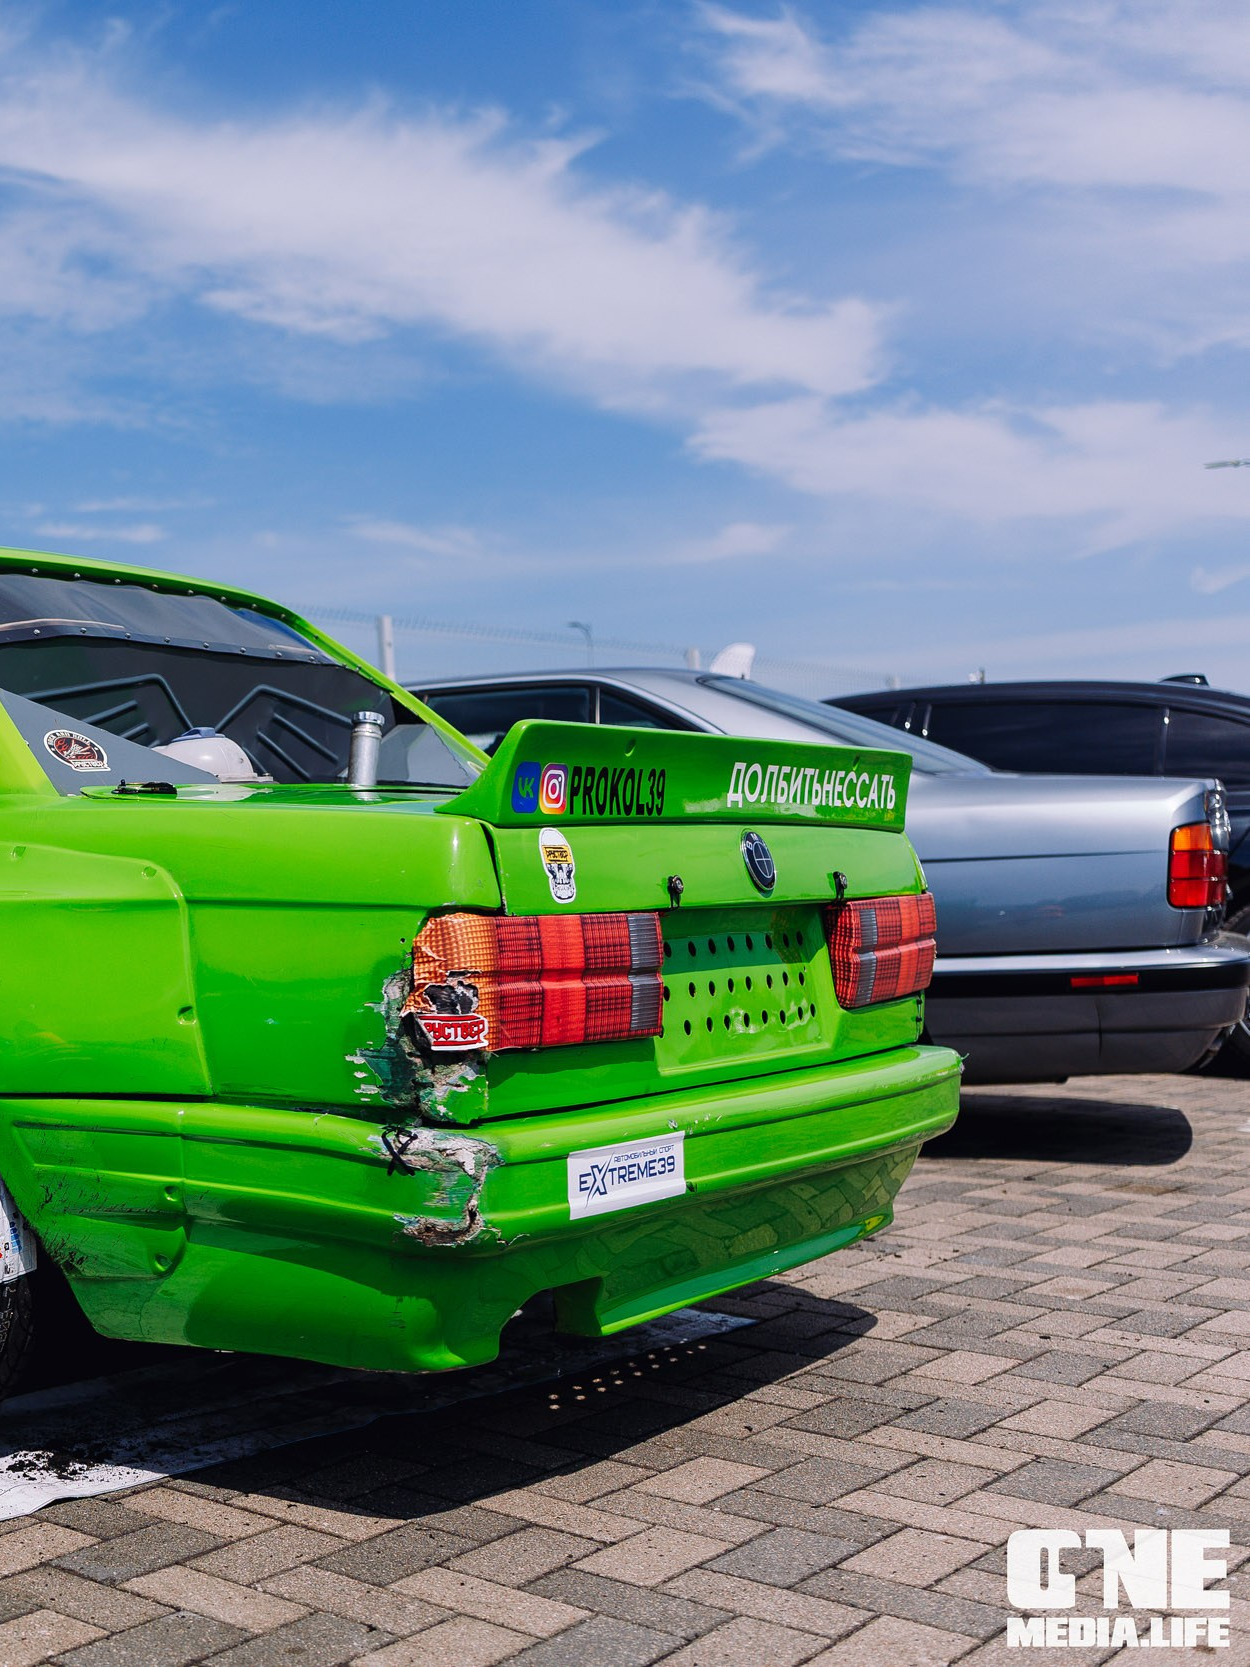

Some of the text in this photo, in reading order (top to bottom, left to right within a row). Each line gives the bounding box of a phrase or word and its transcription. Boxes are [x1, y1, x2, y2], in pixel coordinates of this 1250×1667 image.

[569, 765, 666, 817] PROKOL39
[727, 762, 895, 810] ДОЛБИТЬНЕССАТЬ
[579, 1152, 675, 1203] EXTREME39
[613, 1145, 674, 1162] АВТОМОБИЛЬНЫЙ СПОРТ
